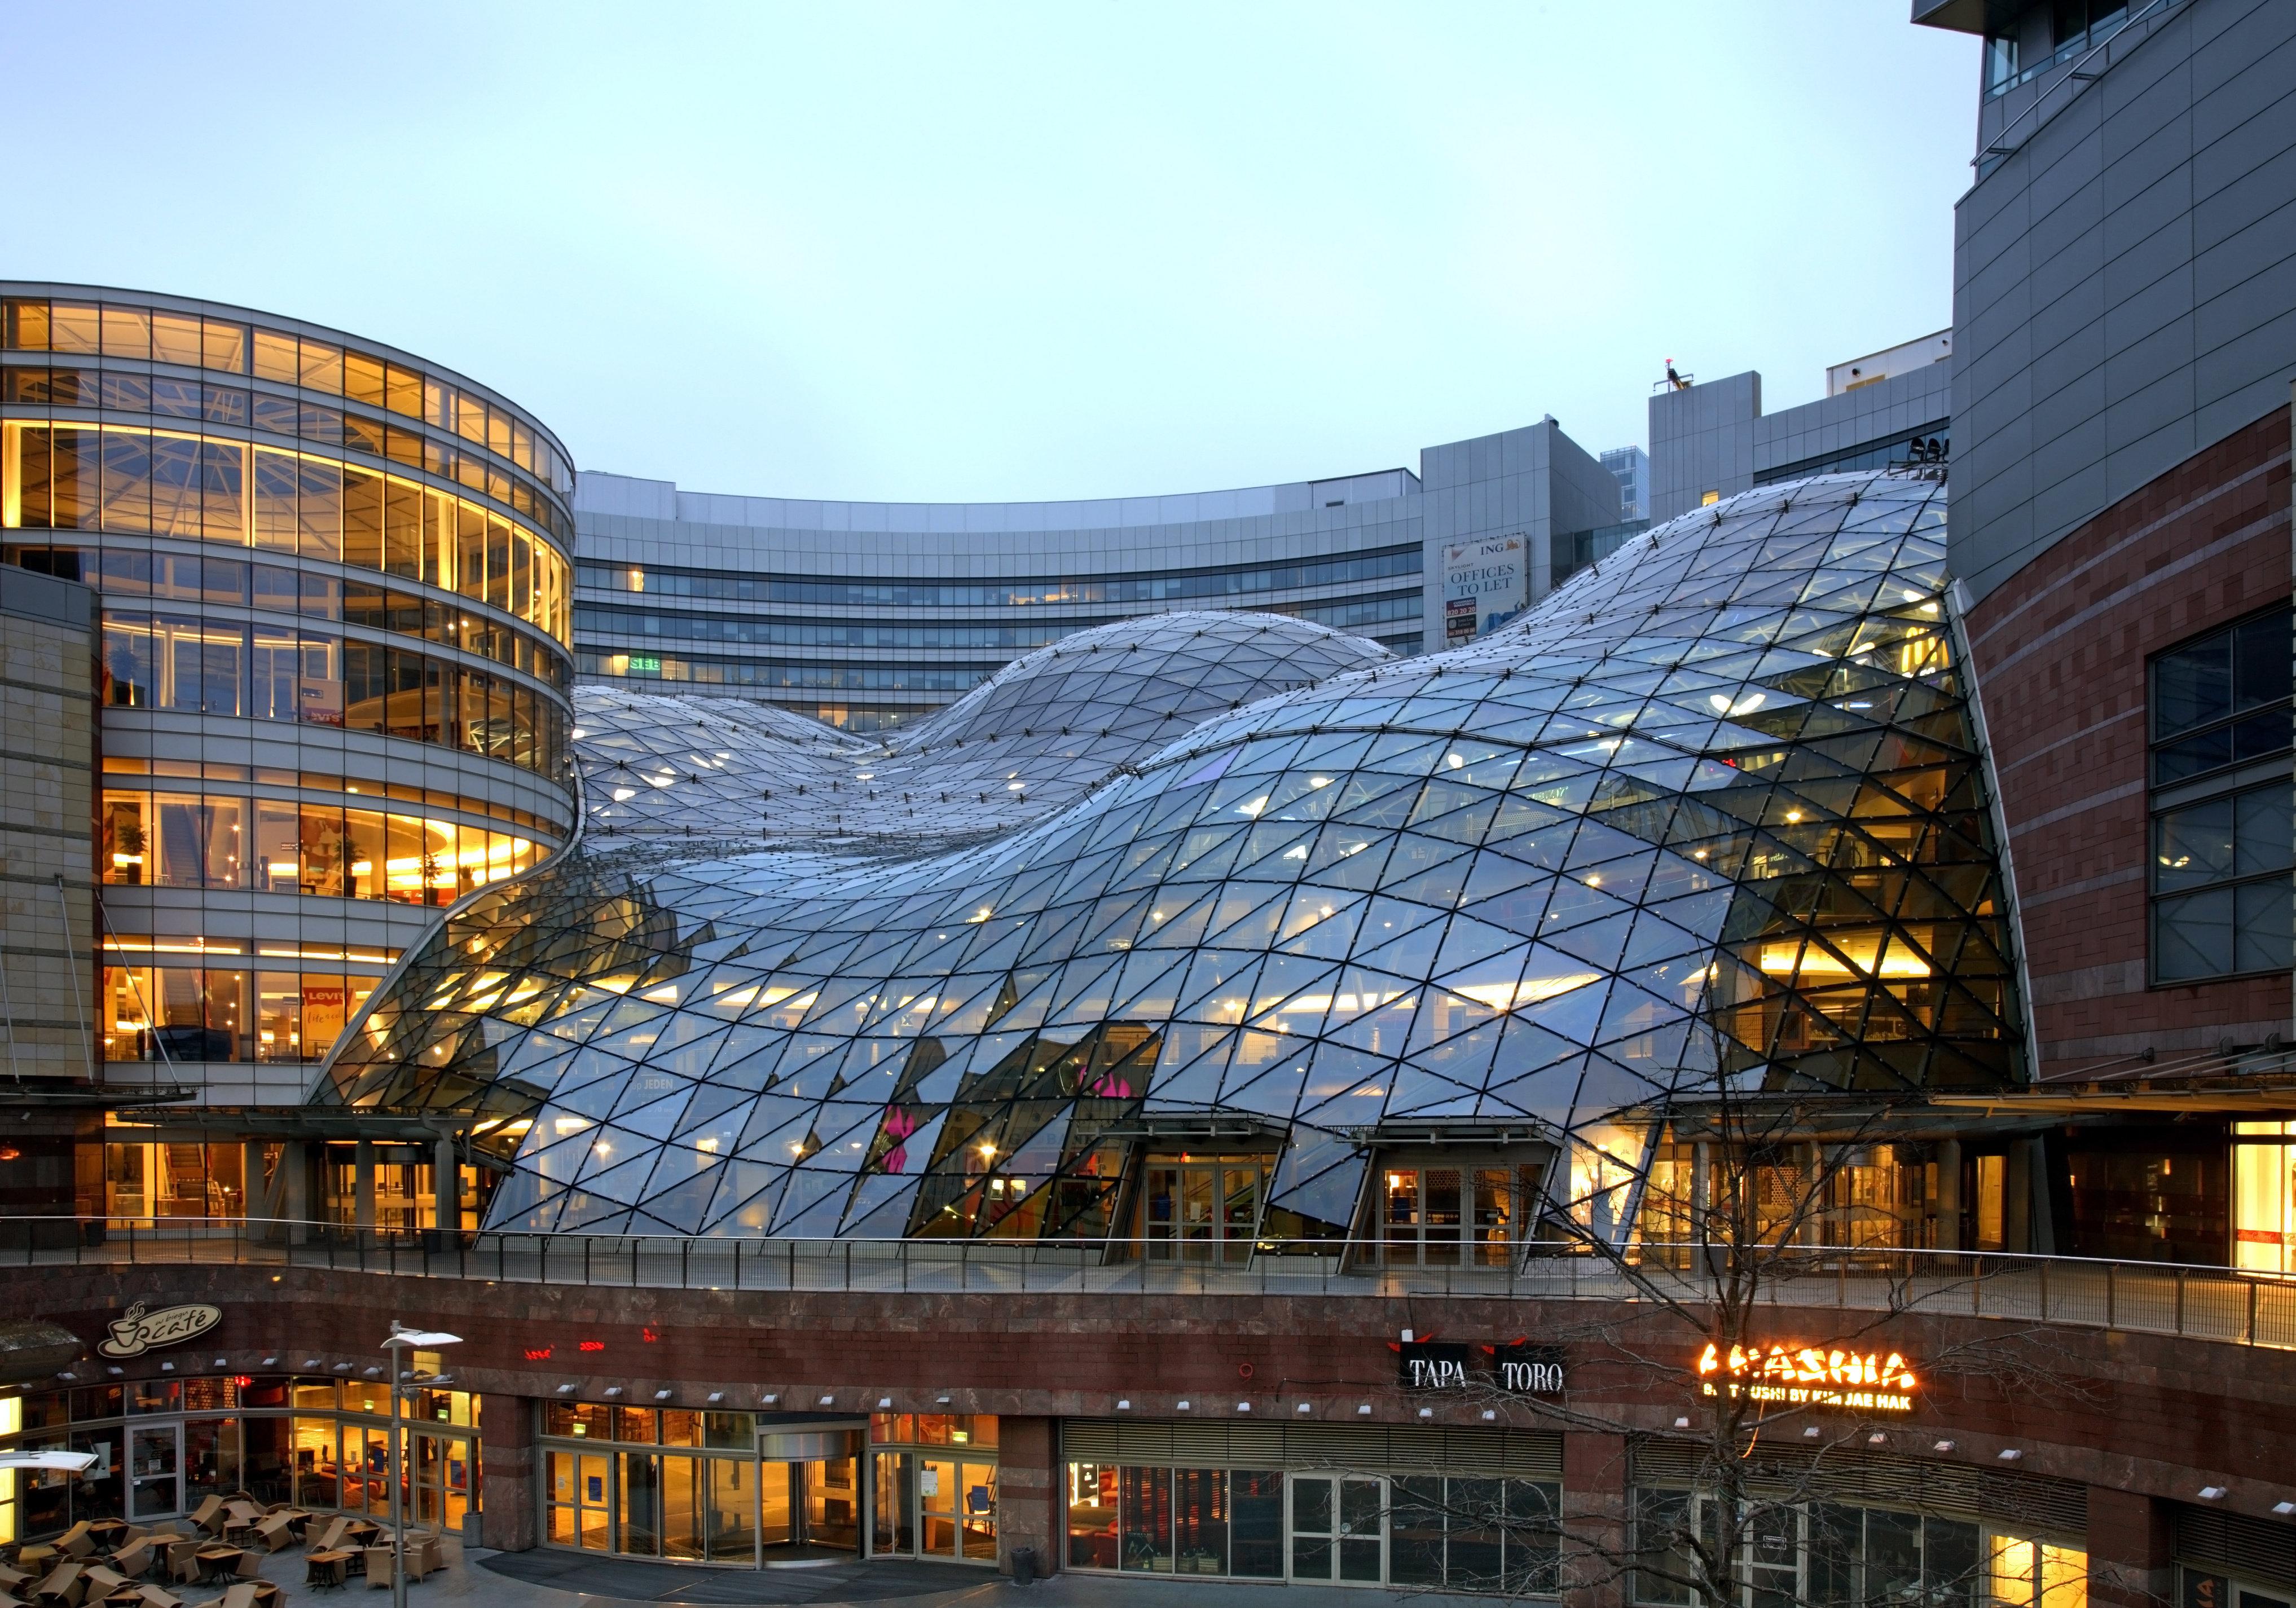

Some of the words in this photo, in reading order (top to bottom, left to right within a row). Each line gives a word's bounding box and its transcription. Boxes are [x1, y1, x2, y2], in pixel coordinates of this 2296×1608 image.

[1480, 543, 1504, 556] ING
[1451, 563, 1515, 584] OFFICES
[1457, 583, 1479, 596] TO
[1484, 578, 1512, 592] LET
[630, 657, 661, 670] SEB
[644, 1078, 673, 1090] JEDEN
[151, 1309, 206, 1340] café
[1410, 1359, 1466, 1387] TAPA
[1502, 1362, 1563, 1391] TORO
[1741, 1385, 1785, 1400] USHI
[1789, 1388, 1809, 1402] BY
[1845, 1393, 1873, 1407] JAE
[1876, 1394, 1911, 1410] HAK
